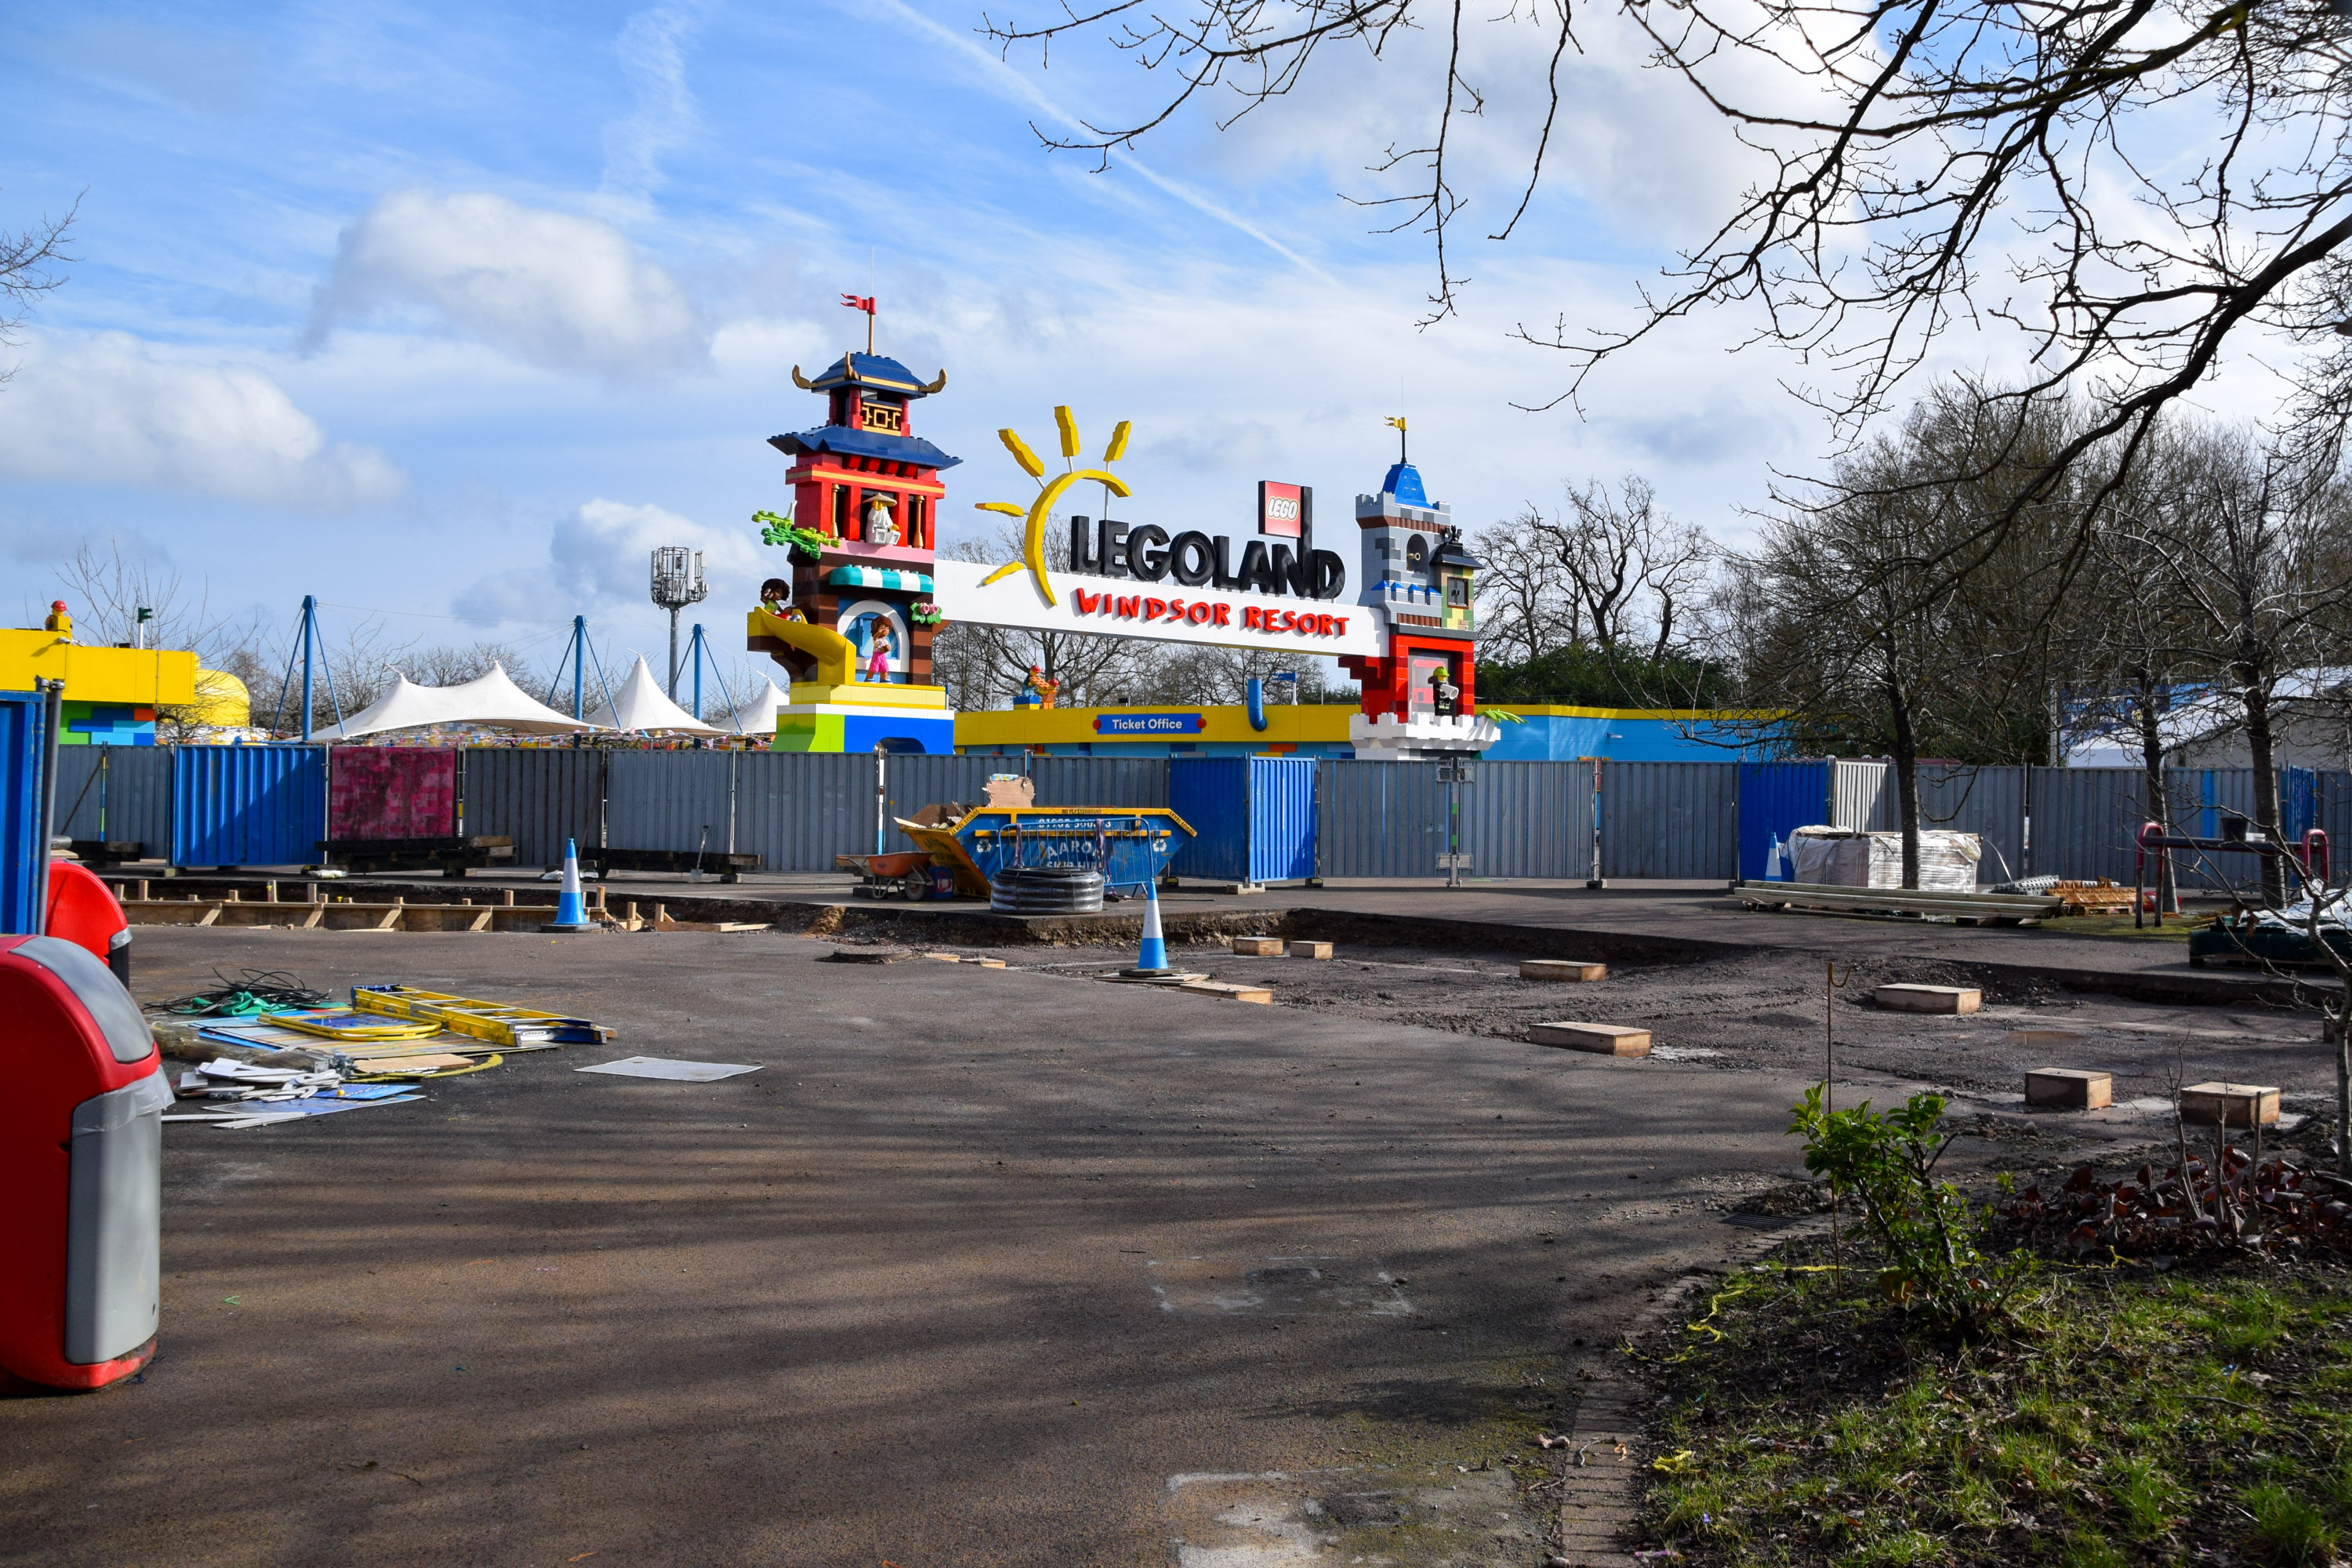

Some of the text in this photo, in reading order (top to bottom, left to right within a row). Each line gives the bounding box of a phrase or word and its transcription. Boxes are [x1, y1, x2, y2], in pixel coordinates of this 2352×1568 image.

[1267, 497, 1299, 521] LEGO
[1070, 515, 1345, 600] LEGOLAND
[1076, 588, 1350, 636] WINDSOR RESORT
[1112, 718, 1182, 730] Ticket Office
[964, 809, 980, 823] LOADS
